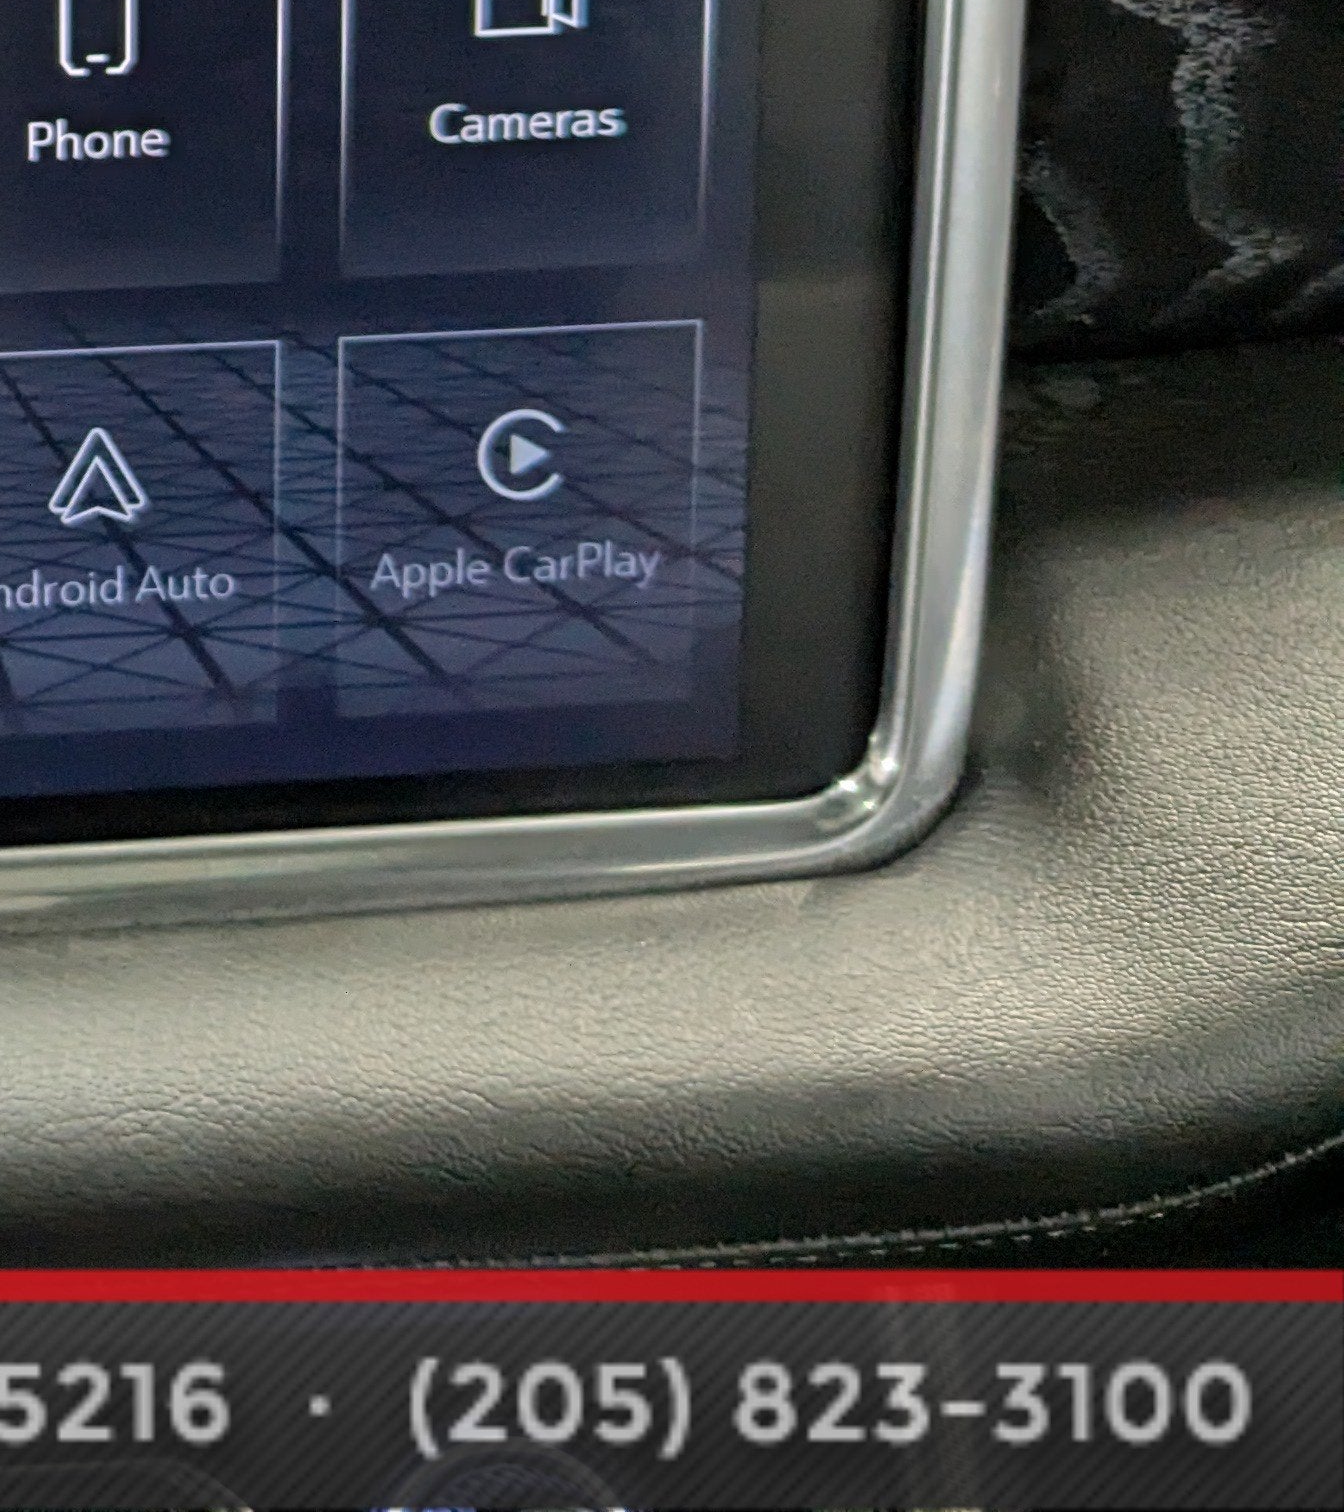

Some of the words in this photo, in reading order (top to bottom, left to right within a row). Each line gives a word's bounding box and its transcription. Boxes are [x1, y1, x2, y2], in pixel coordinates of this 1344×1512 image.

[26, 117, 171, 163] Phone
[427, 101, 629, 147] Cameras
[134, 564, 237, 604] Auto
[369, 546, 491, 601] Apple
[502, 539, 663, 590] CarPlay
